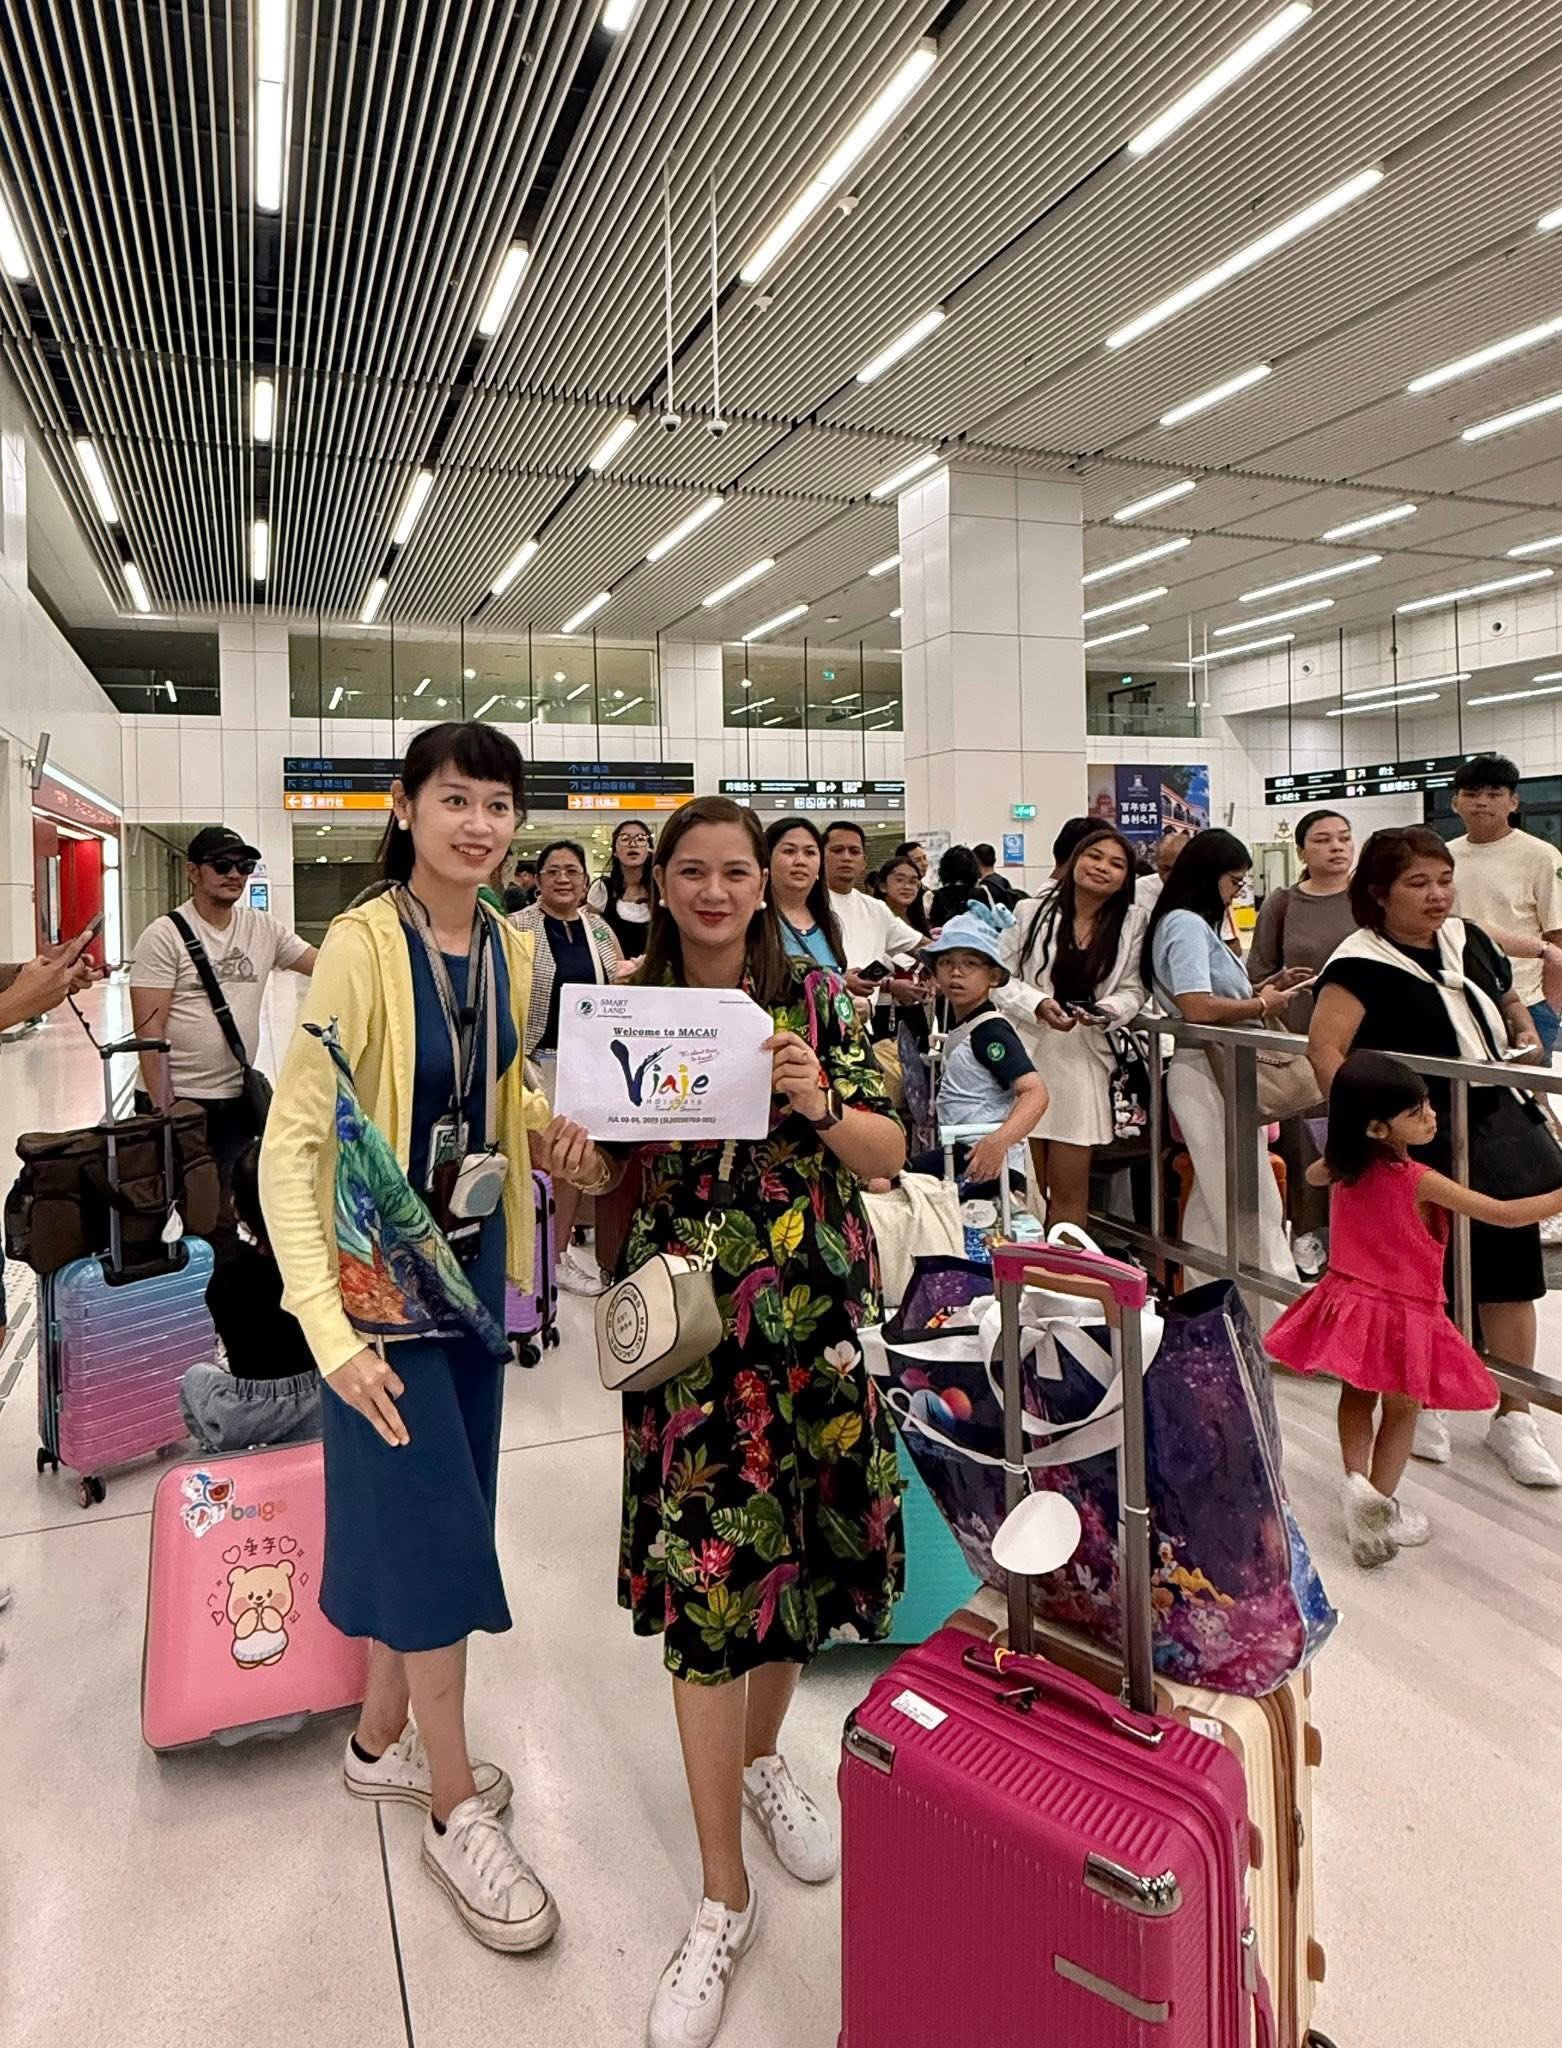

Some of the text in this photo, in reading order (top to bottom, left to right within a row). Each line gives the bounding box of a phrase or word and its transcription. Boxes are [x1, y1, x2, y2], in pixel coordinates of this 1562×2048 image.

[600, 998, 628, 1007] SMART
[613, 1027, 718, 1037] Welcome to MACAU
[610, 1039, 709, 1113] Viaje
